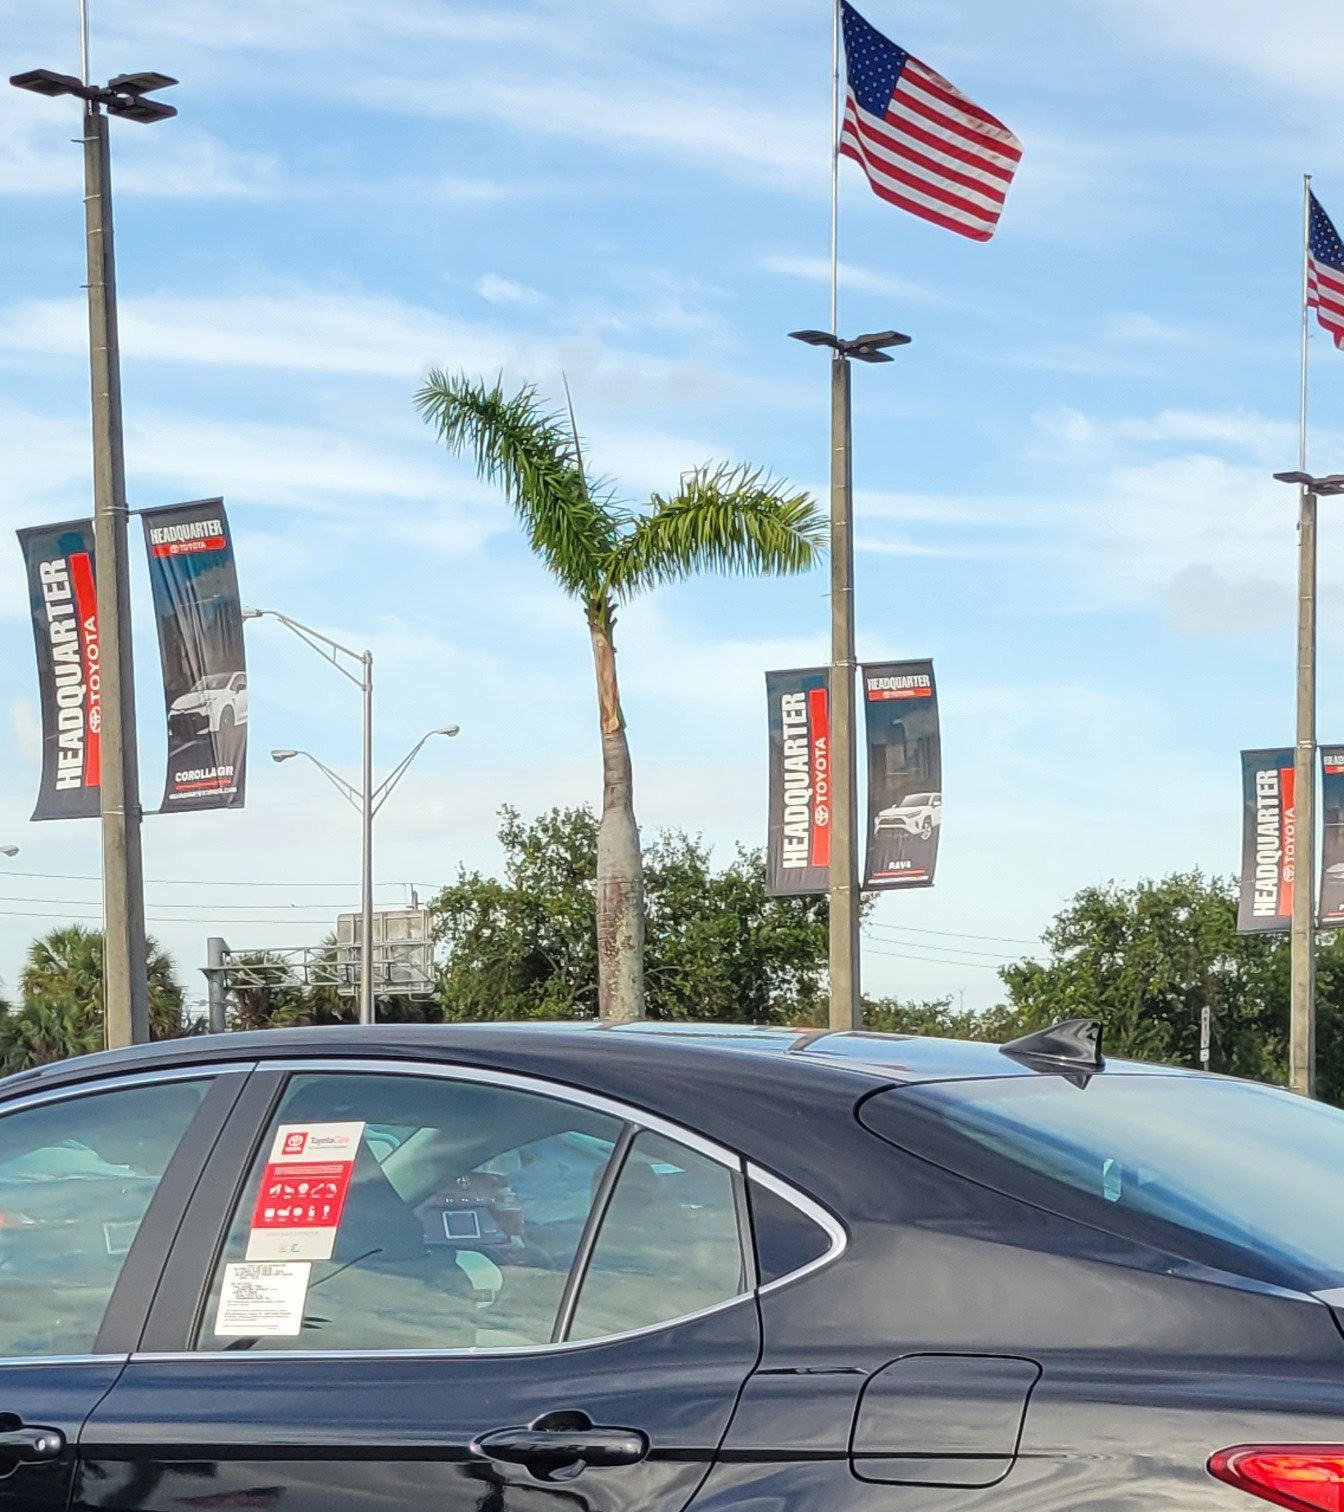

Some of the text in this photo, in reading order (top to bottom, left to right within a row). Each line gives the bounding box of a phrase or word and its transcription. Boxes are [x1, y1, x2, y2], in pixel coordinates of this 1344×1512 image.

[150, 520, 223, 545] HEADQUARTER
[40, 559, 86, 790] HEADQUARTER
[85, 617, 102, 706] TOYOTA
[867, 675, 930, 690] HEADQUARTER
[782, 692, 813, 868] HEADQUARTER
[816, 737, 828, 804] TOYOTA
[888, 860, 911, 870] RAV4
[1253, 769, 1283, 916] HEADQUARTER
[1284, 807, 1295, 865] TOYOTA
